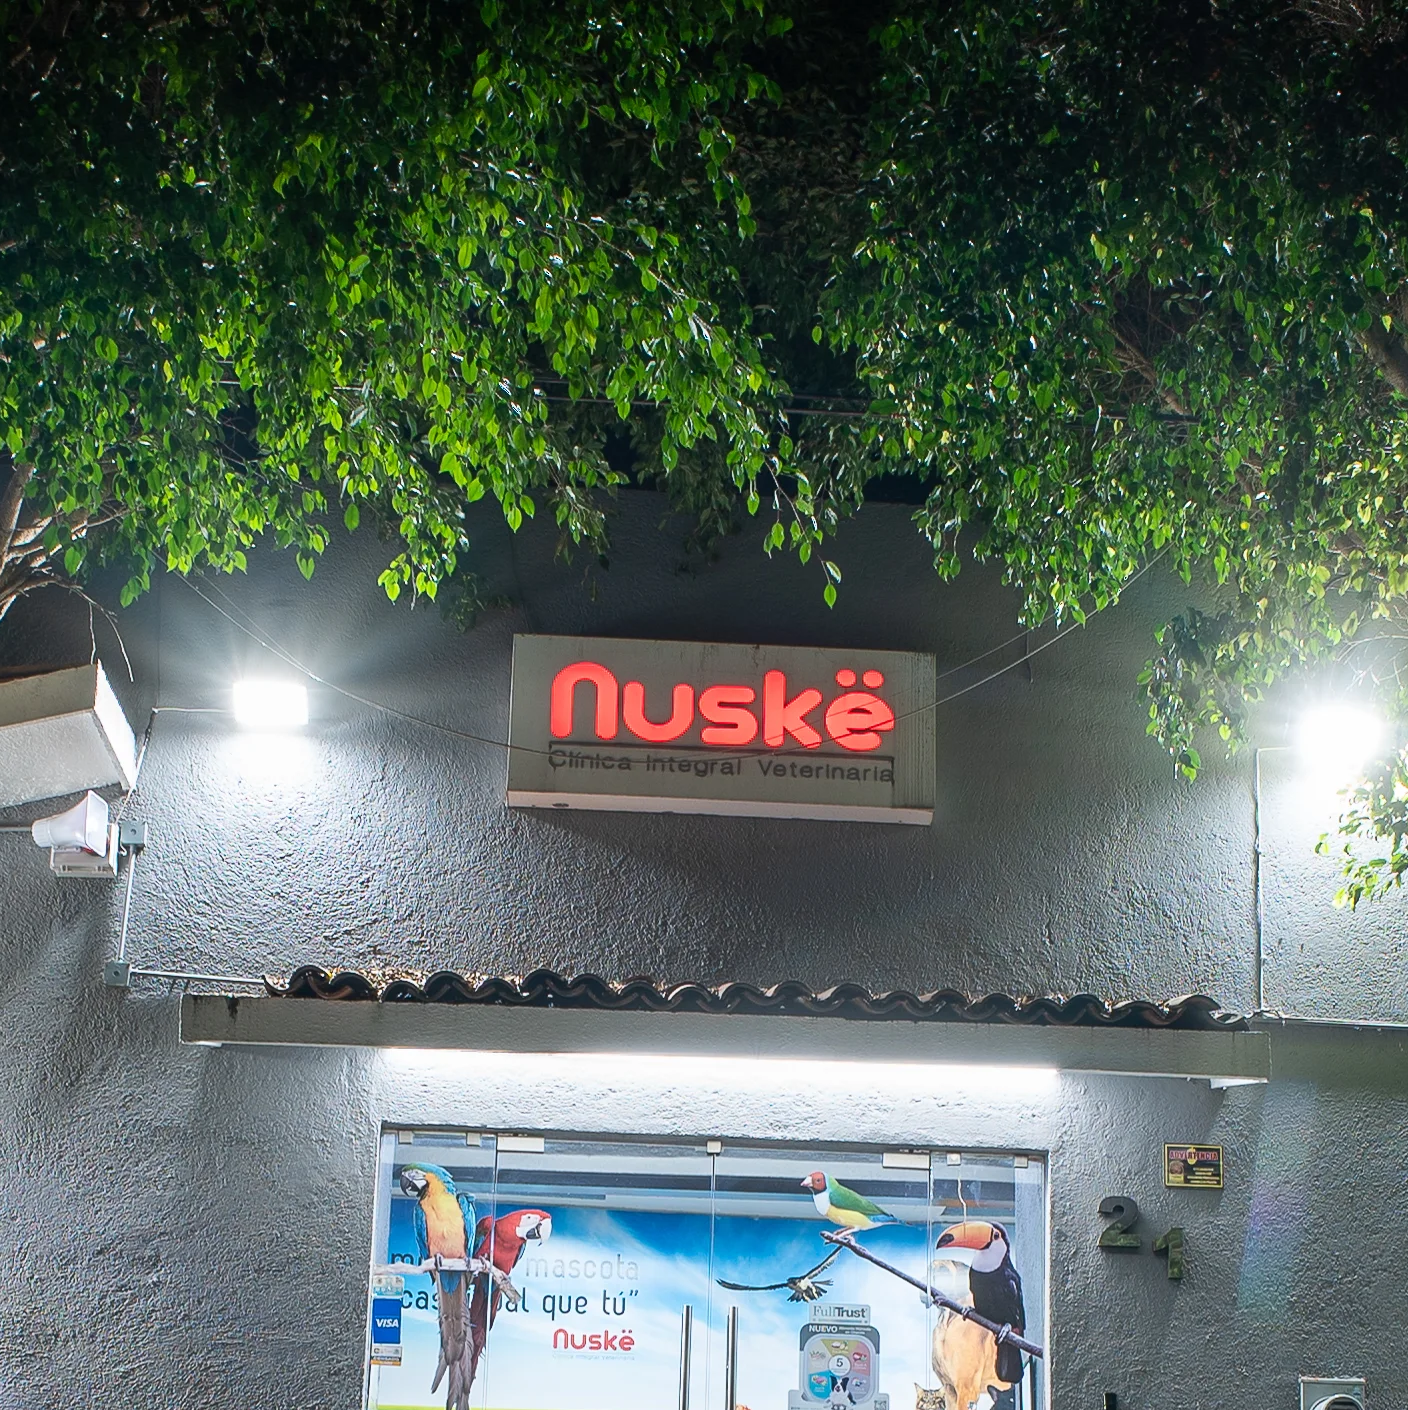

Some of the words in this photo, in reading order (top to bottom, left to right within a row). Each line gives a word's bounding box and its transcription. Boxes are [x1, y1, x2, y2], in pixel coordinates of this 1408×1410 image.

[548, 750, 631, 771] Clínica
[646, 754, 741, 777] Integral
[758, 759, 893, 782] Veterinaria
[525, 1253, 639, 1281] mascota
[542, 1294, 588, 1321] que
[375, 1318, 399, 1328] VISA
[808, 1324, 838, 1333] NUEVO
[836, 1357, 843, 1367] 5
